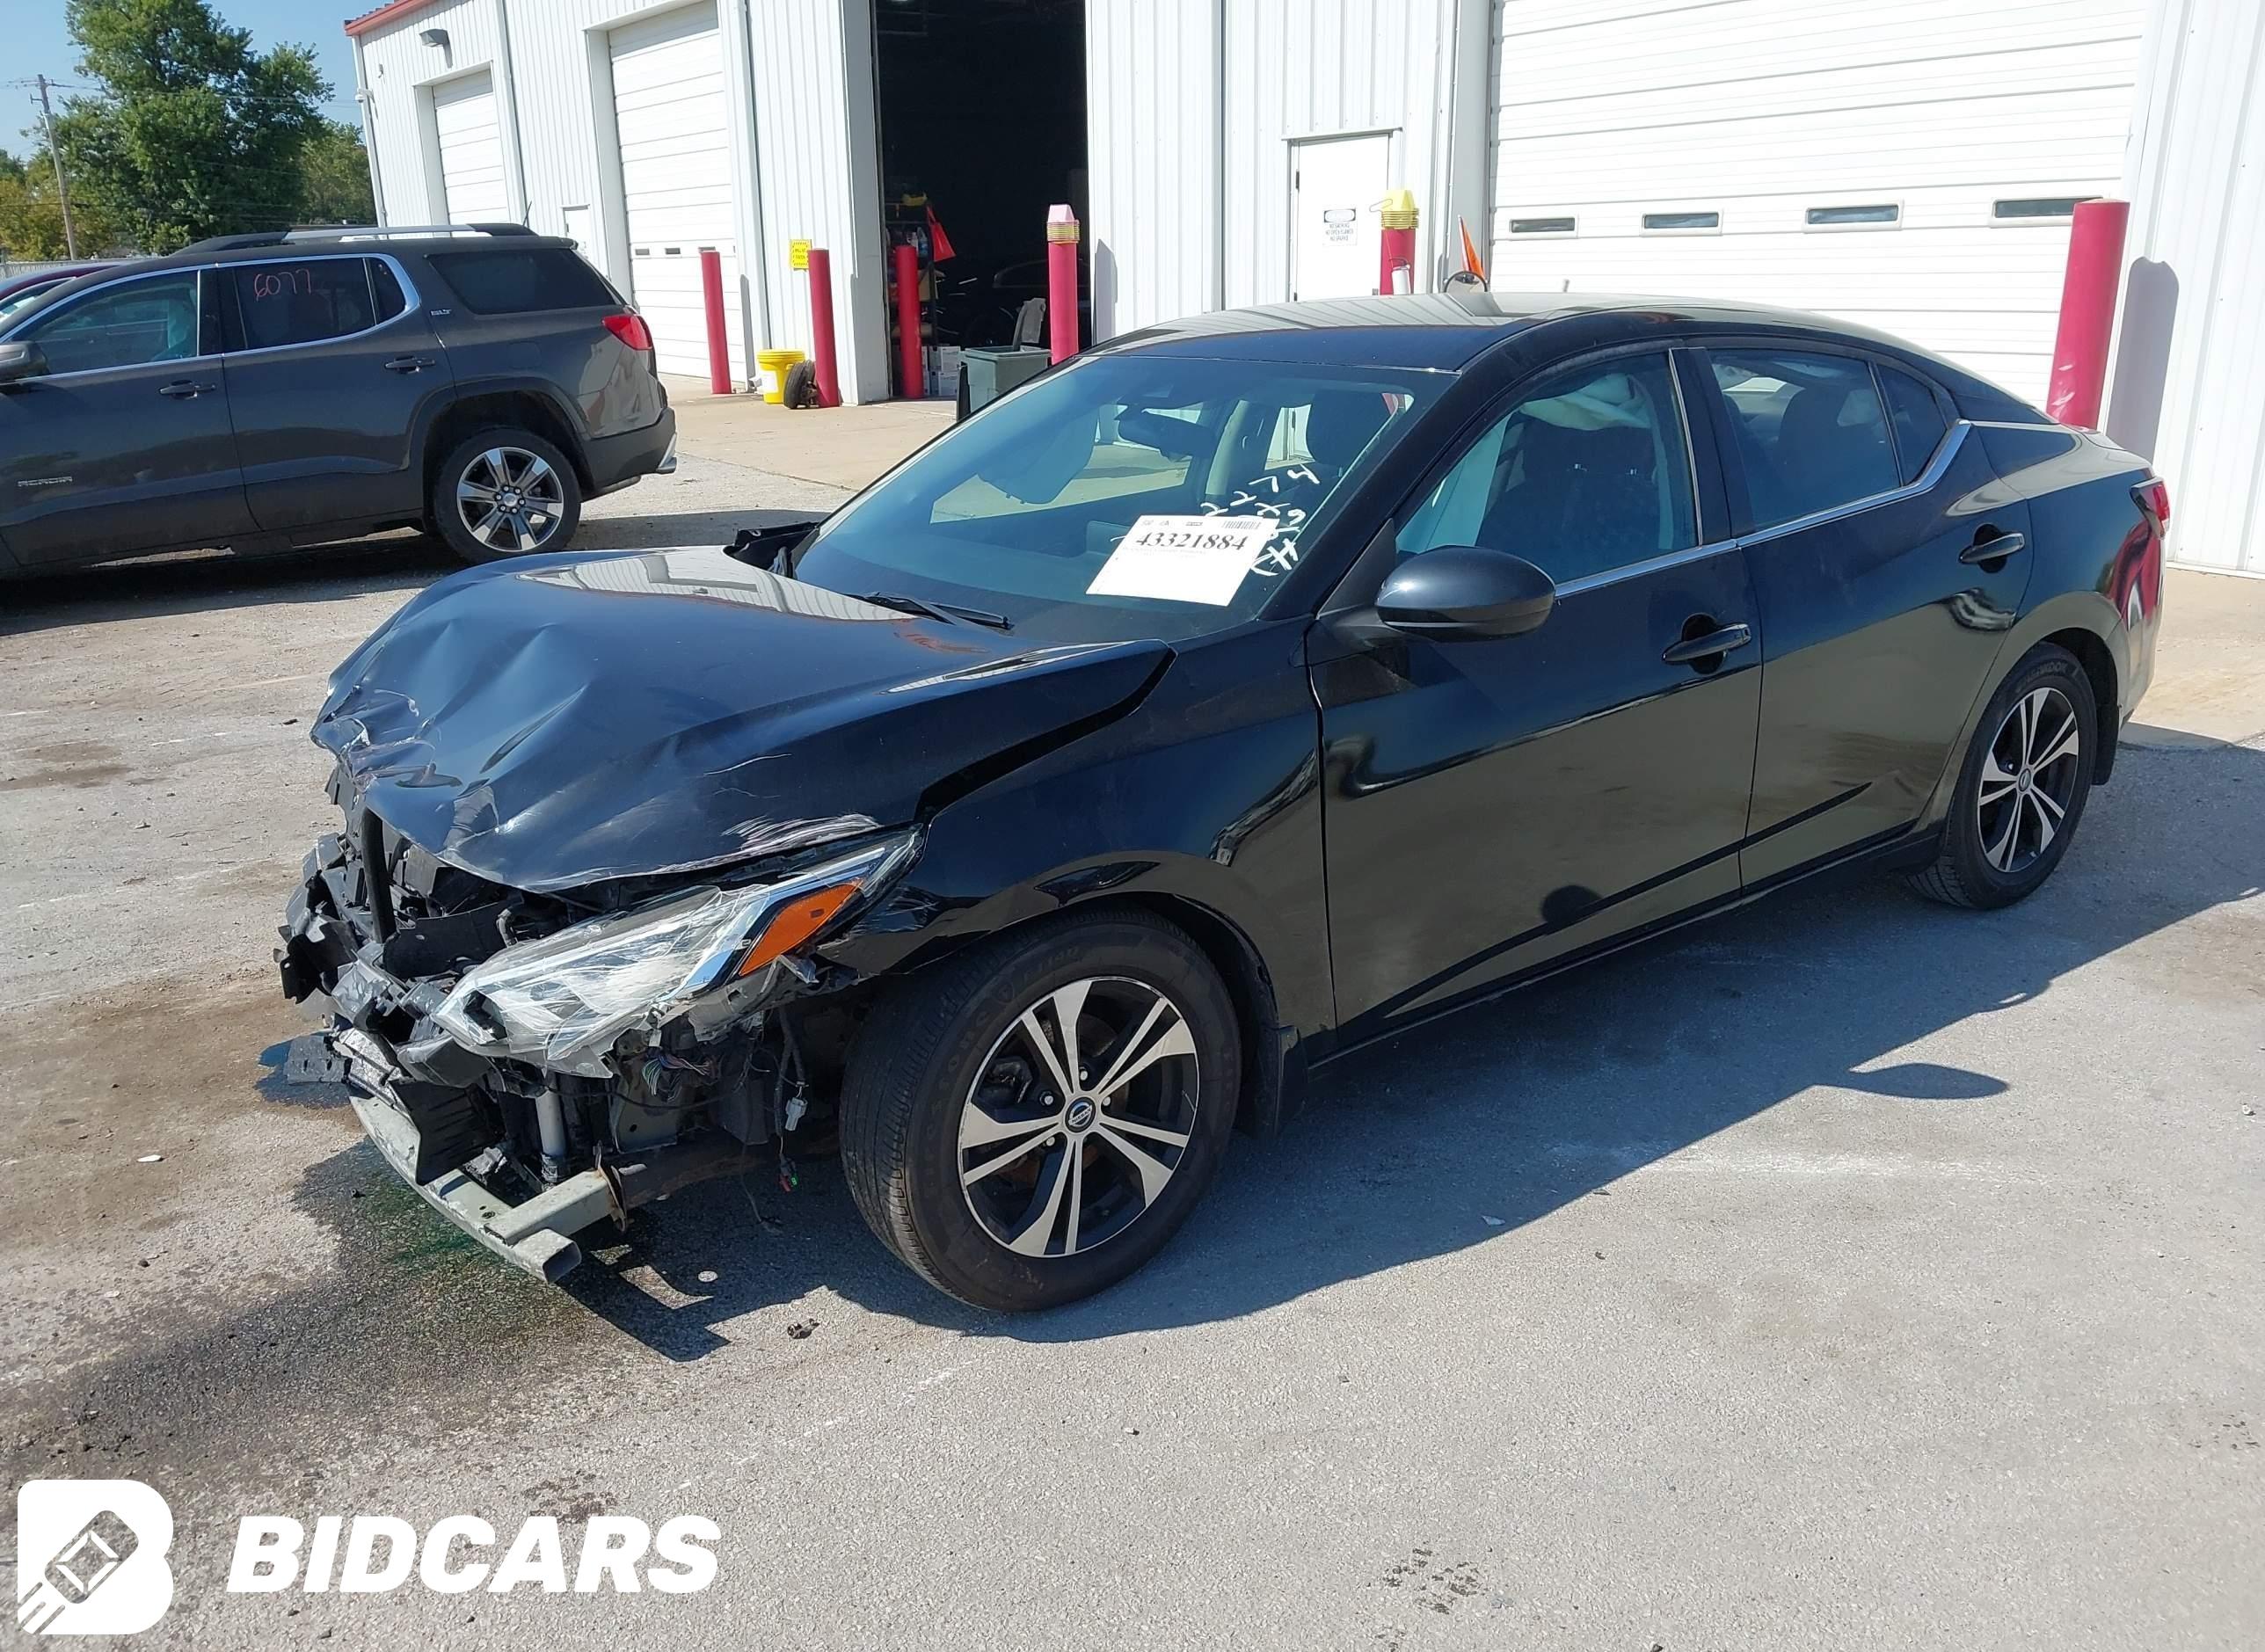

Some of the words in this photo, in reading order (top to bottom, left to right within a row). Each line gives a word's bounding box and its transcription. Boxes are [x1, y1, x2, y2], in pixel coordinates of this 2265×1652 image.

[253, 268, 311, 302] 6077
[1135, 531, 1249, 551] 43321884
[1071, 1108, 1091, 1124] NISSAN
